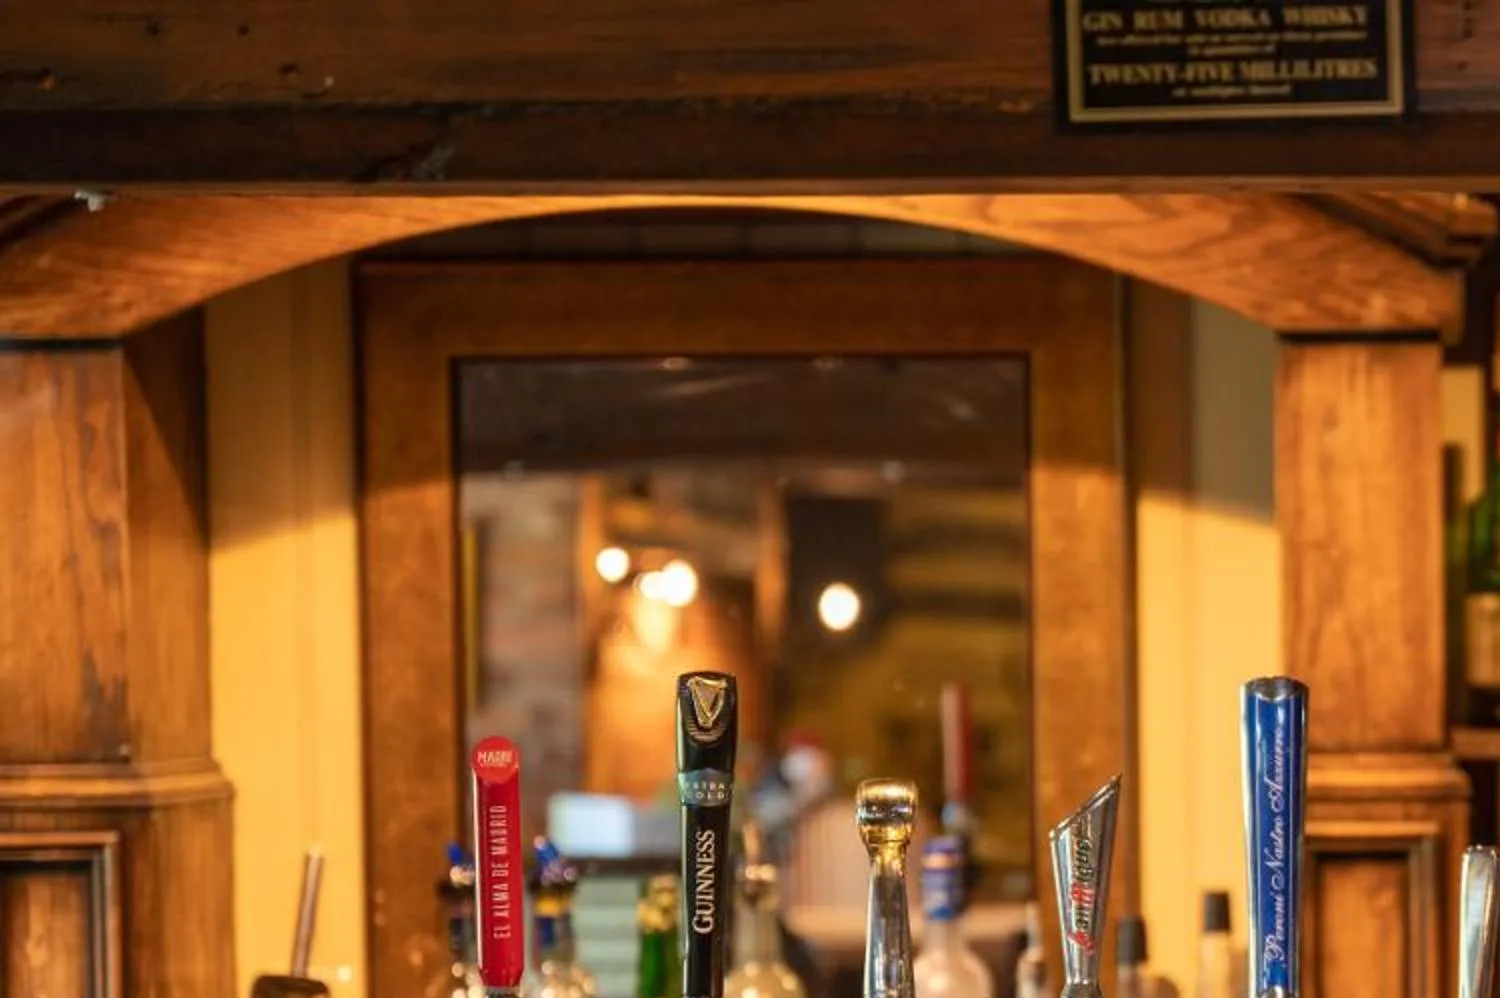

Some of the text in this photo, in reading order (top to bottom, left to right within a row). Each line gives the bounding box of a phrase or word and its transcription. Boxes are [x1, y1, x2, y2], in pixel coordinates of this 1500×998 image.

[489, 804, 512, 939] EL ALMA DE MADRID
[692, 828, 716, 934] GUINNESS
